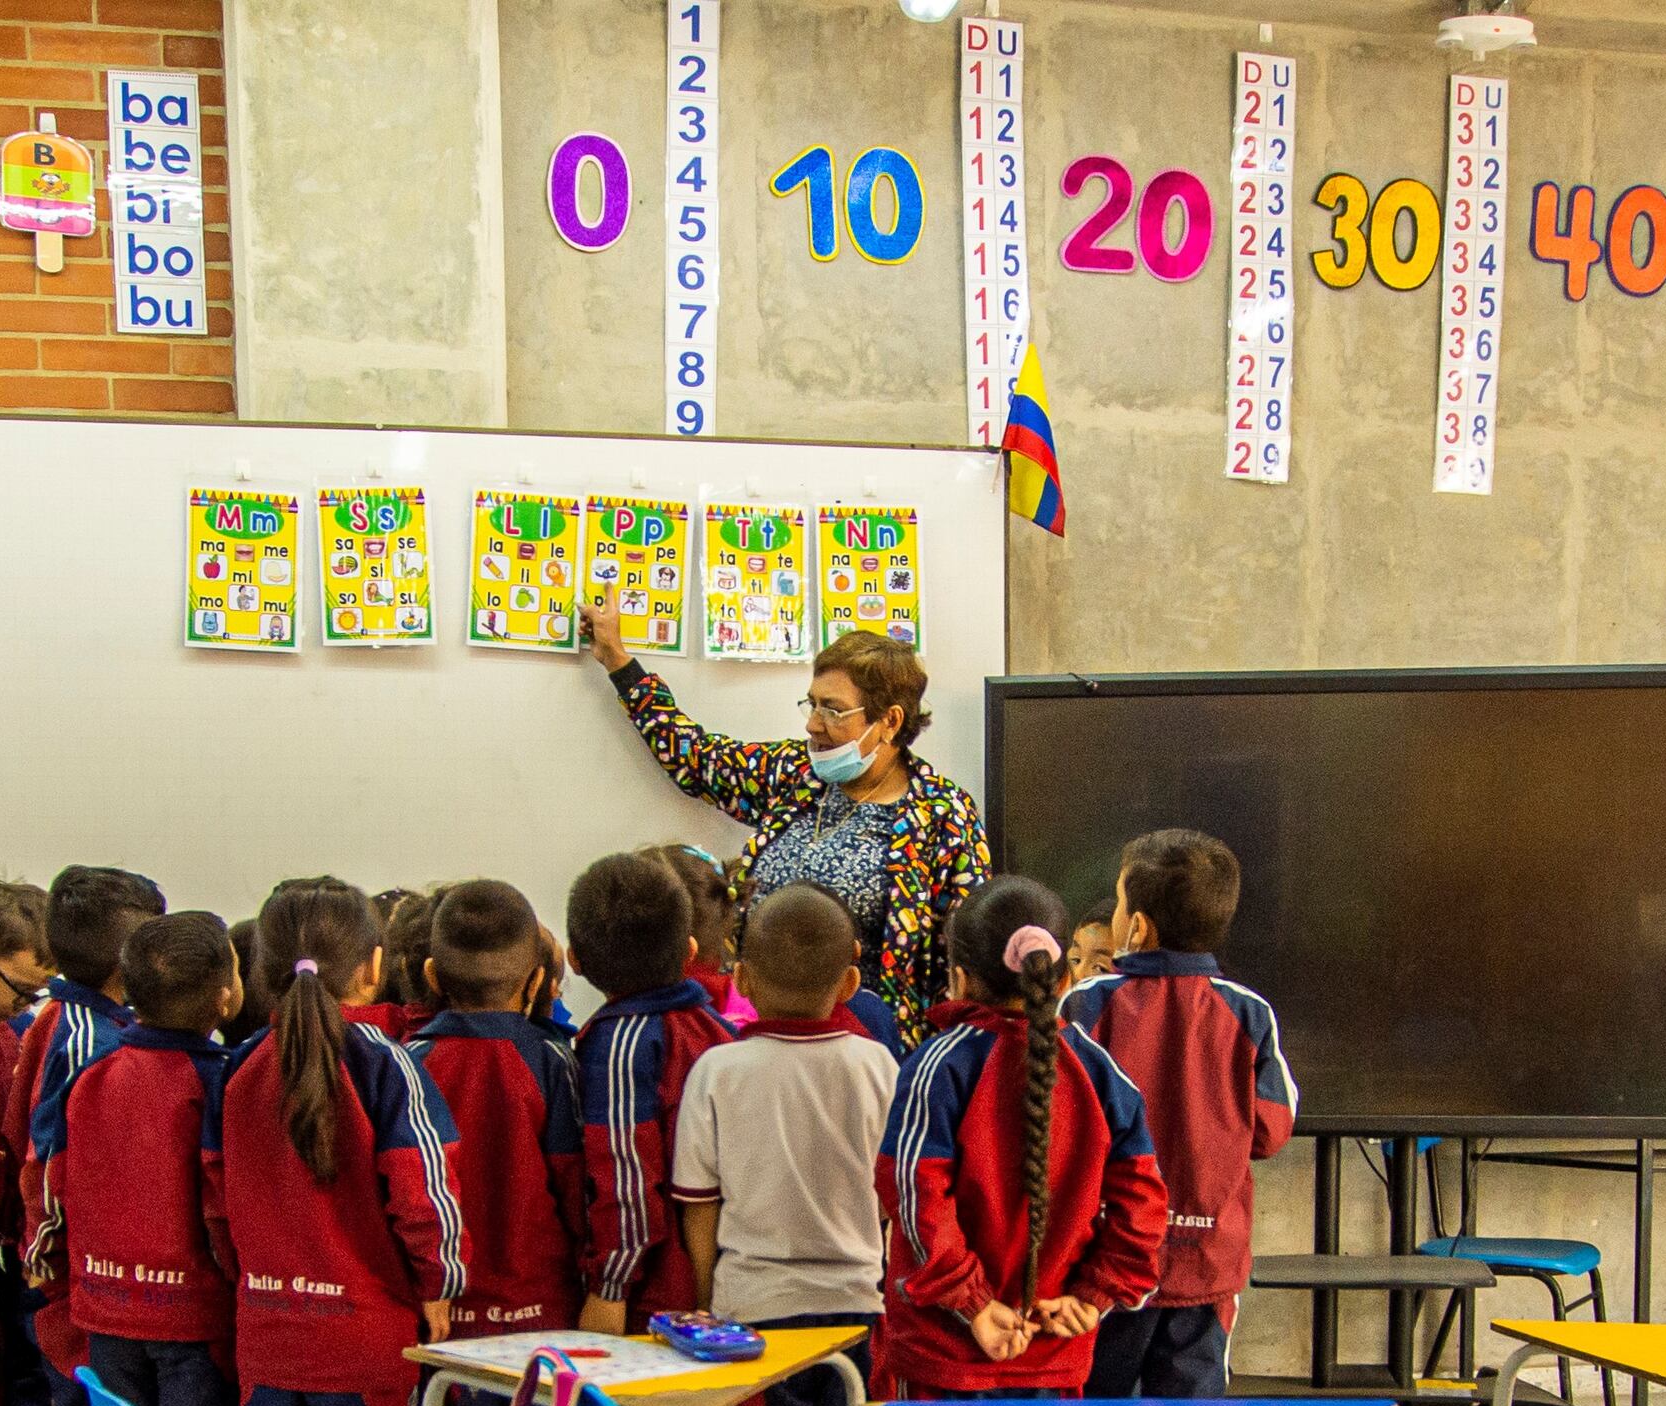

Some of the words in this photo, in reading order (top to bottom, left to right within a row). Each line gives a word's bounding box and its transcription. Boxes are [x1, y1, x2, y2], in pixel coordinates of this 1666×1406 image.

[681, 5, 700, 42] 1
[679, 56, 706, 93] 2
[122, 82, 188, 126] ba
[679, 106, 706, 143] 3
[35, 143, 55, 162] B
[125, 130, 190, 174] be
[546, 131, 633, 252] 0
[676, 157, 707, 192] 4
[770, 143, 926, 264] 10
[1060, 154, 1215, 283] 20
[679, 206, 706, 242] 5
[1312, 172, 1442, 290] 30
[128, 233, 193, 277] bo
[678, 255, 705, 290] 6
[130, 285, 193, 327] bu
[680, 304, 707, 339] 7
[678, 352, 705, 387] 8
[672, 400, 708, 440] 9
[201, 541, 225, 552] ma
[265, 546, 288, 557] me
[335, 538, 354, 551] sa
[489, 537, 503, 552] la
[551, 544, 564, 558] le
[597, 542, 617, 557] pa
[656, 547, 676, 560] pe
[832, 554, 850, 566] na
[890, 554, 908, 566] ne
[234, 572, 252, 583] mi
[200, 596, 223, 607] mo
[264, 601, 287, 612] mu
[834, 606, 852, 617] no
[86, 1255, 124, 1279] Julio
[248, 1273, 282, 1291] Julio
